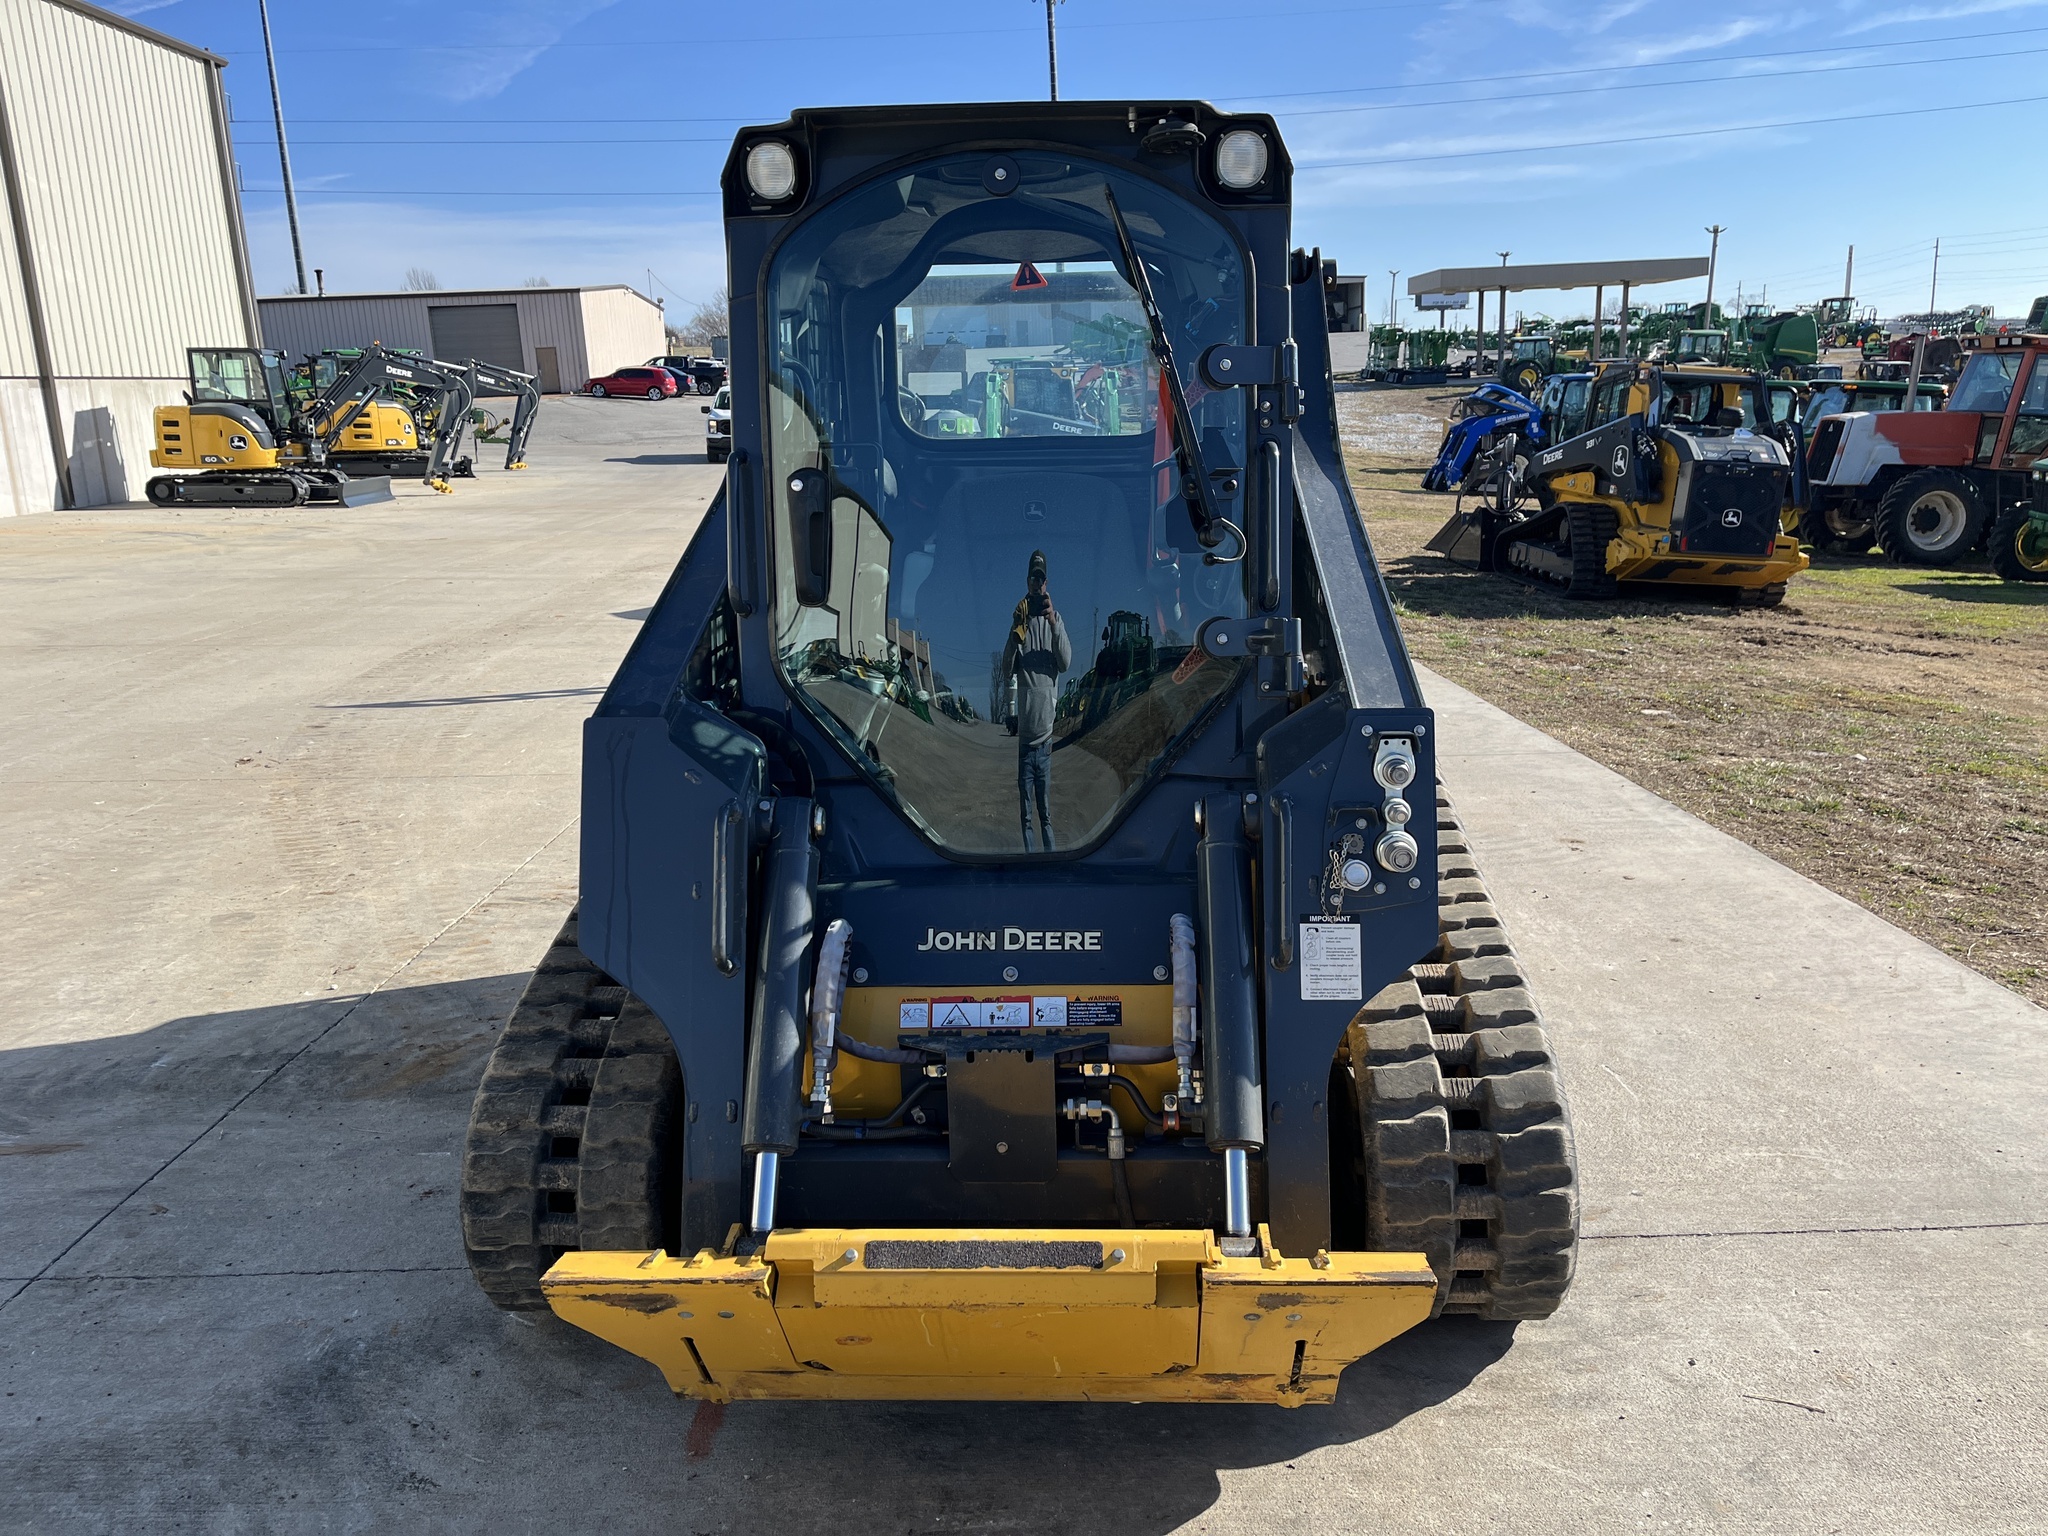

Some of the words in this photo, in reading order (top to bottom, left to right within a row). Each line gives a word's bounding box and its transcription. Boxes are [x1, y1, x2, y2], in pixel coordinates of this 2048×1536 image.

[386, 365, 413, 378] DEERE
[1052, 422, 1083, 435] DEERE
[1543, 449, 1564, 465] DEERE
[918, 928, 996, 951] JOHN
[1003, 927, 1101, 951] DEERE
